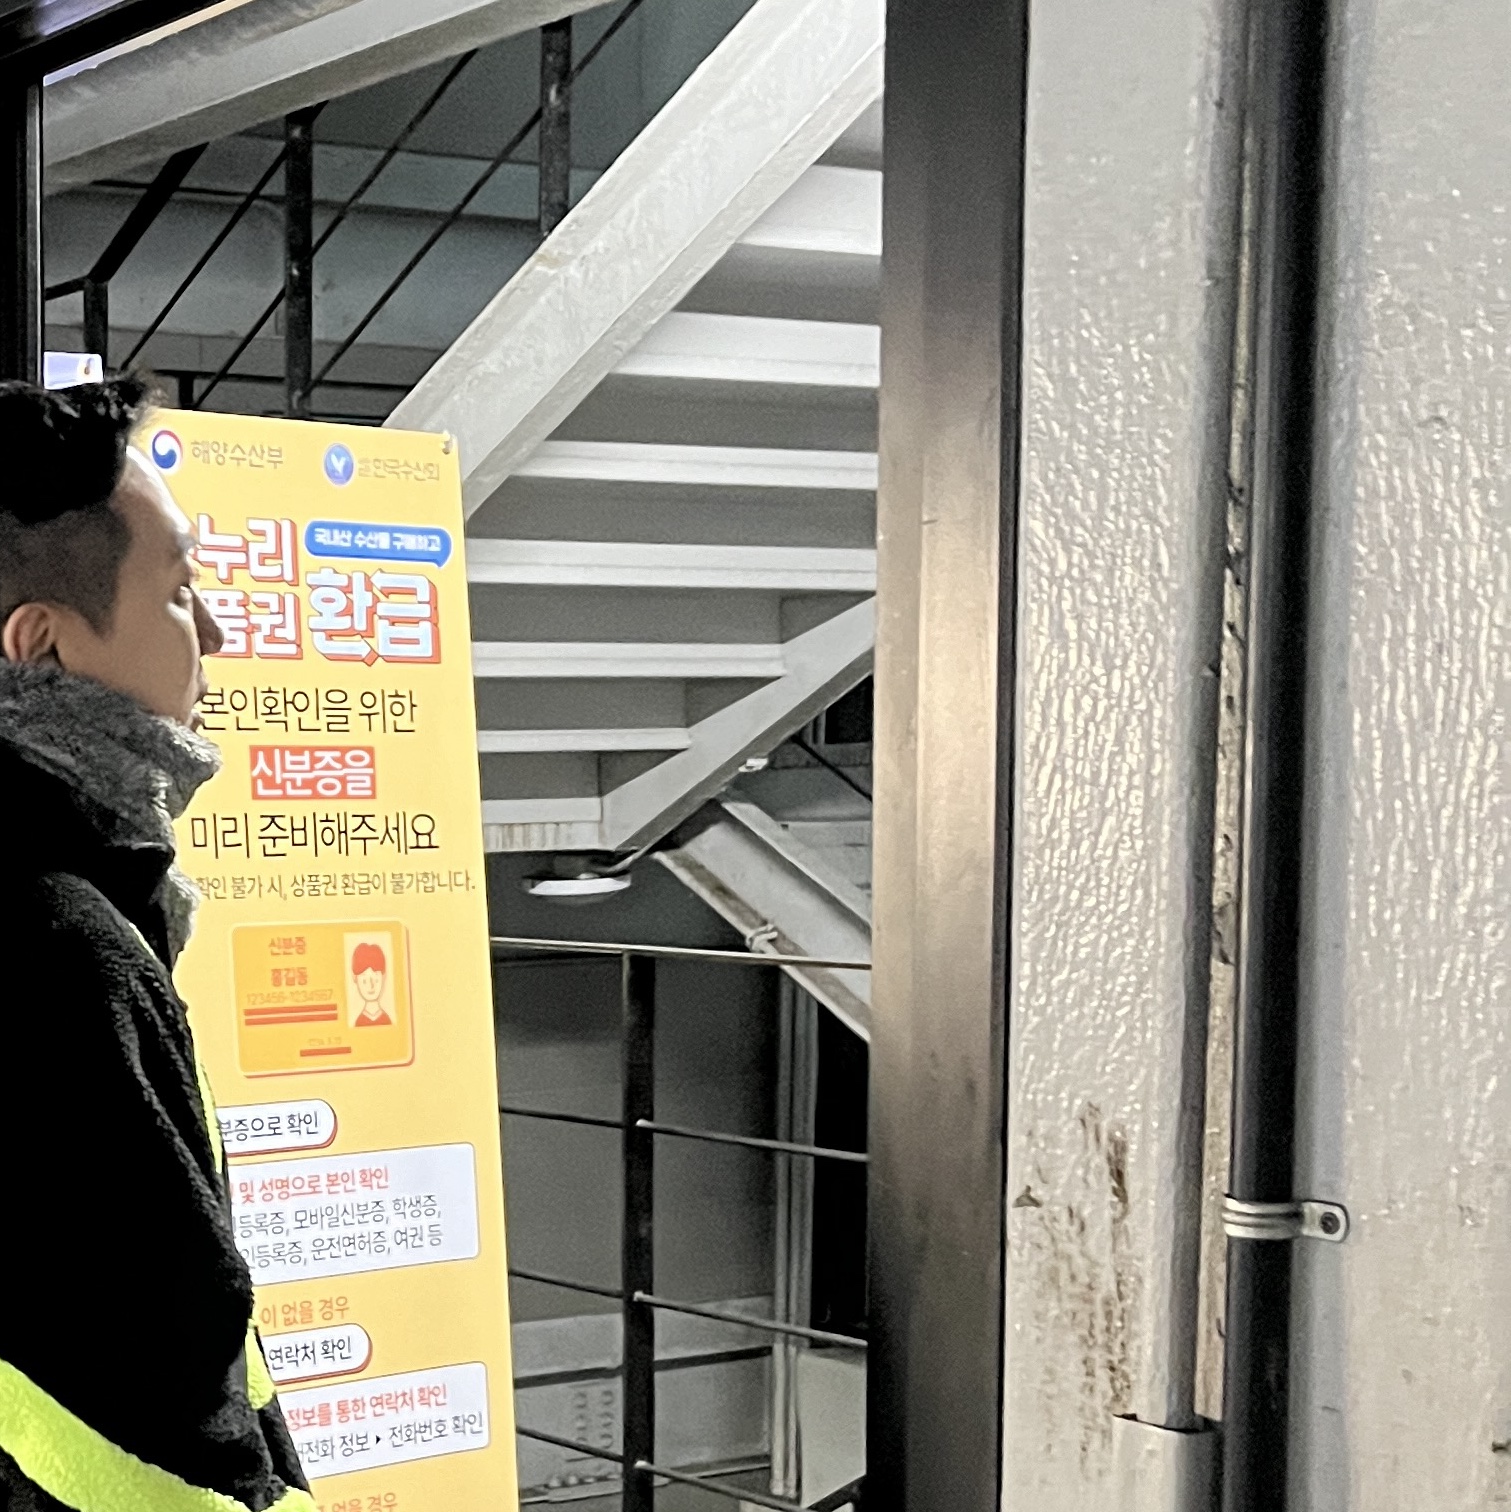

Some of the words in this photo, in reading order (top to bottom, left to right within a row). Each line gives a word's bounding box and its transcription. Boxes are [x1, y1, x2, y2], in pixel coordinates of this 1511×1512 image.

[190, 440, 284, 470] 해양수산부
[195, 513, 299, 586] 누리
[305, 567, 441, 667] 환급
[200, 686, 352, 733] 본인확인을
[358, 688, 418, 733] 위한
[251, 748, 374, 797] 신분증을
[191, 812, 250, 859] 미리
[258, 811, 440, 858] 준비해주세요
[231, 875, 263, 899] 불가
[266, 874, 288, 901] 시,
[290, 873, 338, 898] 상품권
[341, 871, 387, 896] 환급이
[390, 870, 476, 894] 불가합니다.
[286, 1110, 319, 1137] 확인
[239, 1181, 255, 1205] 및
[258, 1174, 323, 1203] 성명으로
[325, 1170, 356, 1195] 본인
[359, 1166, 390, 1190] 확인
[293, 1200, 389, 1230] 모바일신분증,
[392, 1193, 442, 1219] 학생증,
[311, 1230, 391, 1262] 운전면허증,
[394, 1225, 424, 1251] 여권
[427, 1223, 444, 1247] 등
[281, 1300, 314, 1327] 없을
[318, 1295, 350, 1321] 경우
[268, 1341, 317, 1371] 연락처
[320, 1336, 352, 1362] 확인
[336, 1397, 367, 1423] 통한
[369, 1389, 415, 1417] 연락처
[417, 1383, 447, 1407] 확인
[339, 1431, 371, 1457] 정보
[388, 1419, 449, 1448] 전화번호
[452, 1411, 484, 1435] 확인
